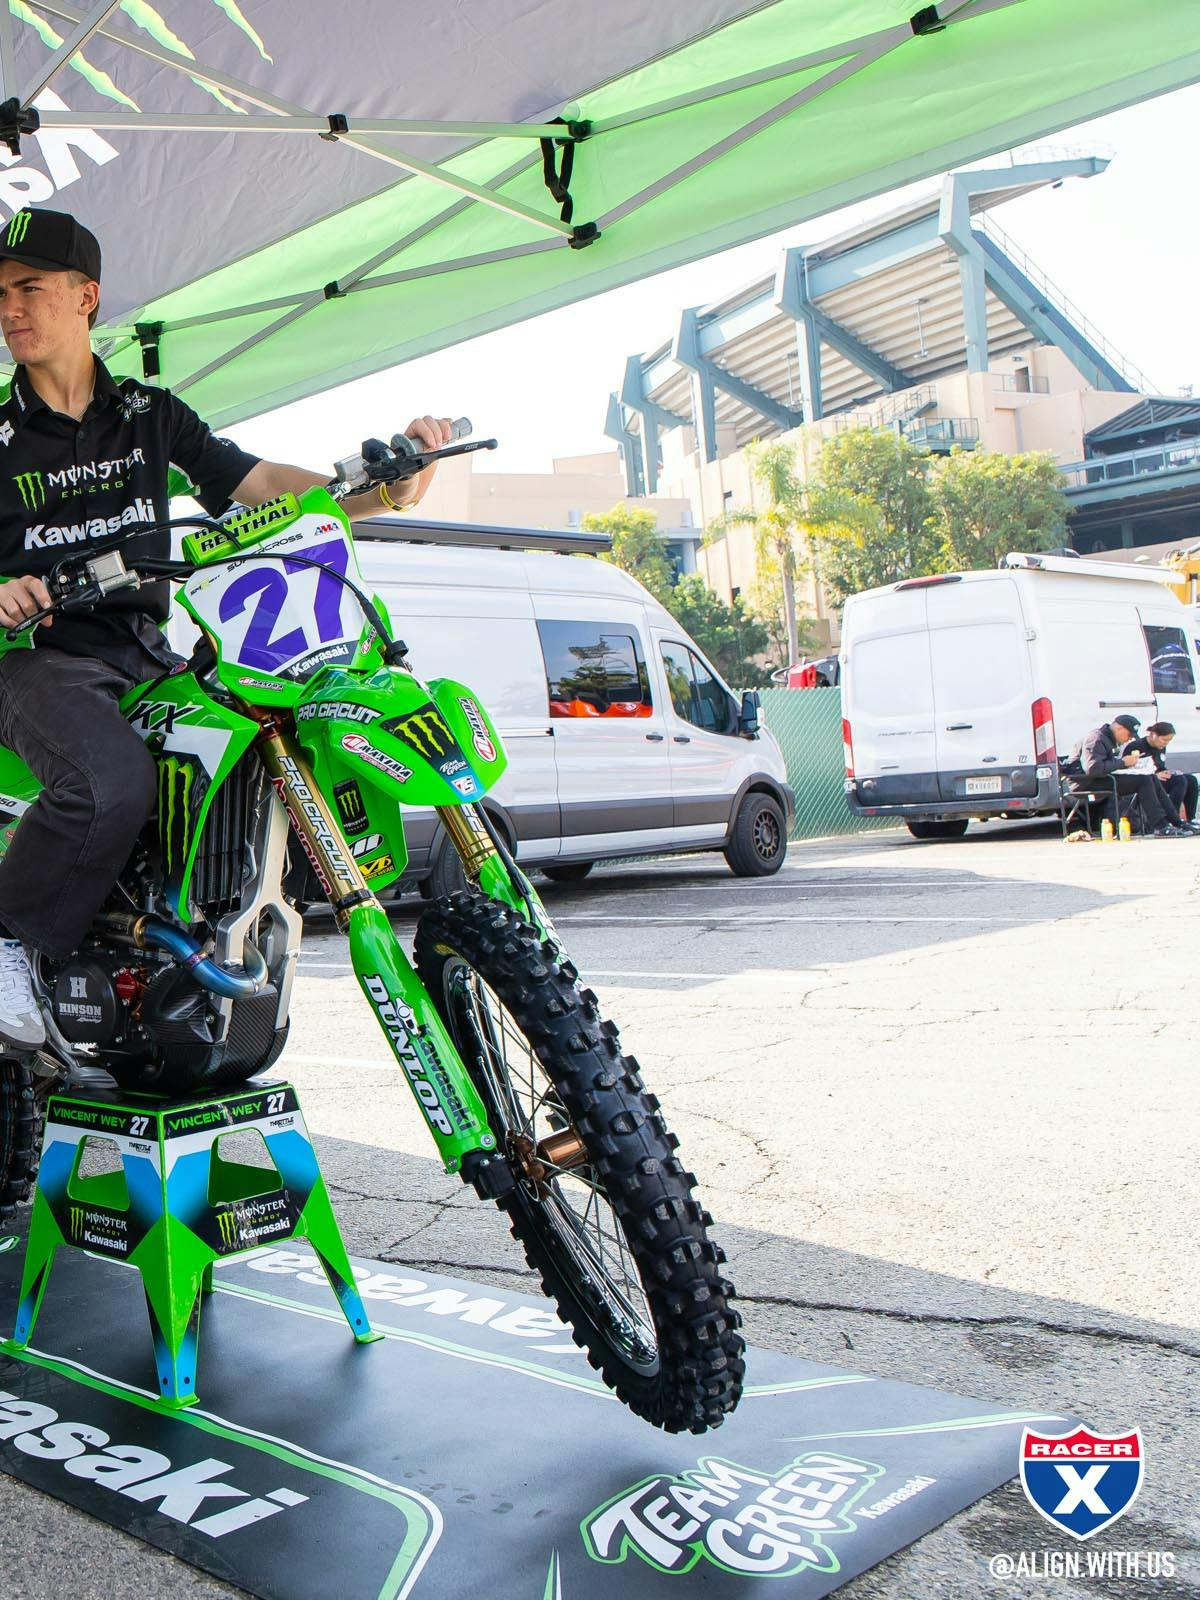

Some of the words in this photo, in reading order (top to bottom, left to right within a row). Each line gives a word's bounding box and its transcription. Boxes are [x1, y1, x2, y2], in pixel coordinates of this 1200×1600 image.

[24, 497, 156, 550] Kawasaki
[314, 522, 340, 536] AMA
[227, 532, 304, 573] SUPRCROSS
[219, 538, 349, 673] 27
[291, 644, 349, 677] Kawasaki
[127, 702, 201, 735] KX
[318, 702, 382, 724] CIRCUIT
[277, 756, 313, 804] PRO
[302, 802, 357, 886] CIRCUIT
[59, 1002, 102, 1016] HINSON
[362, 974, 454, 1136] DUNLOP
[417, 1024, 477, 1132] Kawasaki
[53, 1106, 98, 1124] VINCENT
[100, 1115, 127, 1128] WEY
[129, 1115, 149, 1137] 27
[169, 1111, 229, 1132] VINCENT
[232, 1101, 263, 1117] WEY
[267, 1092, 286, 1114] 27
[85, 1212, 128, 1232] MONSTER
[236, 1199, 287, 1222] MONSTER
[84, 1230, 128, 1252] Kawasaki
[239, 1217, 291, 1241] Kawasaki
[591, 1460, 770, 1567] TEAM
[706, 1455, 869, 1573] GREEN
[855, 1475, 937, 1520] Kawasaki
